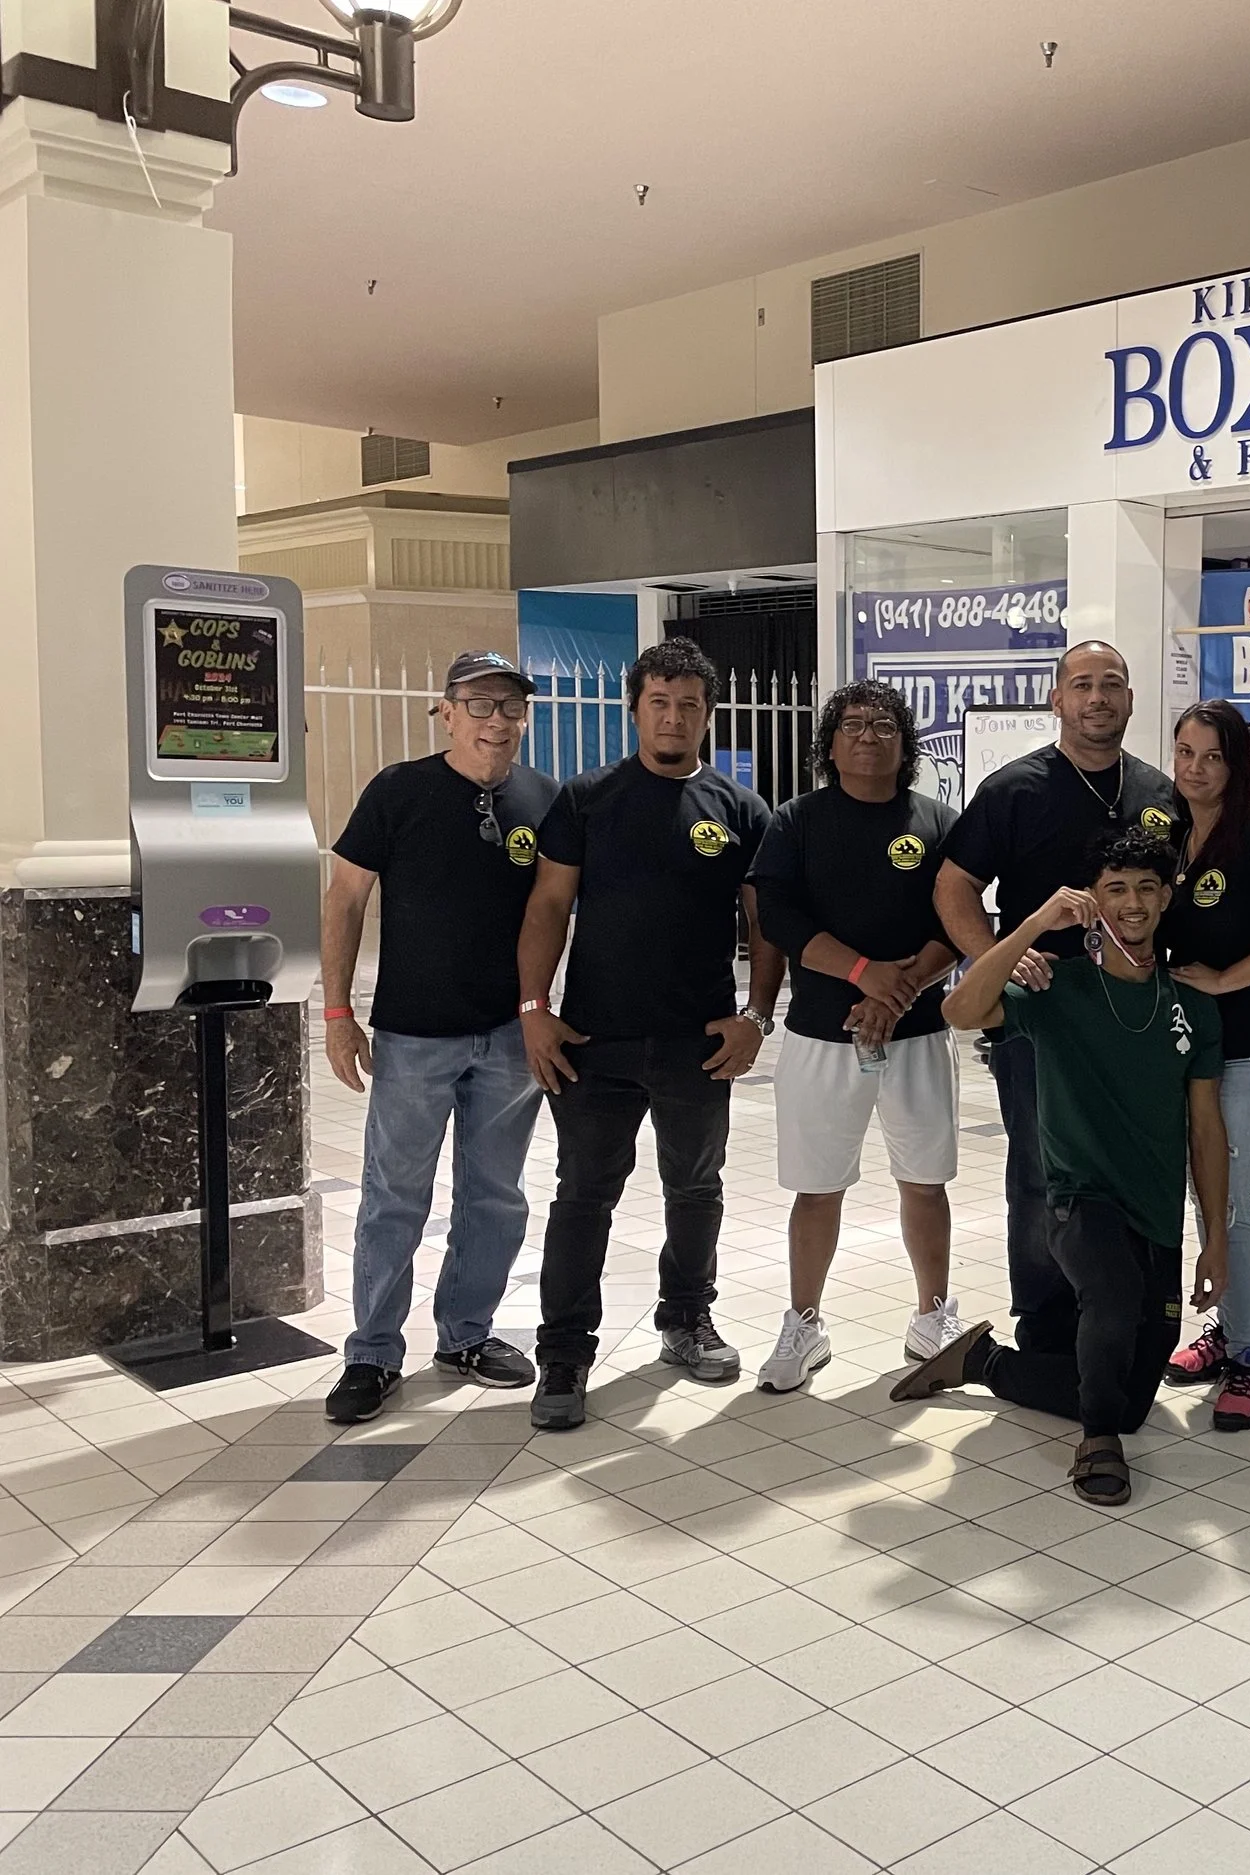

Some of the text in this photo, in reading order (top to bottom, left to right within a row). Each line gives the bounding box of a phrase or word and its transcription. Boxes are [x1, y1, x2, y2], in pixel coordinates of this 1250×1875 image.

[1189, 445, 1212, 480] &
[192, 580, 238, 594] SANITIZE
[190, 618, 241, 639] COPS
[875, 598, 932, 639] (941)
[178, 650, 257, 671] GOBLINS
[974, 715, 1017, 735] JOIN
[223, 795, 244, 805] YOU
